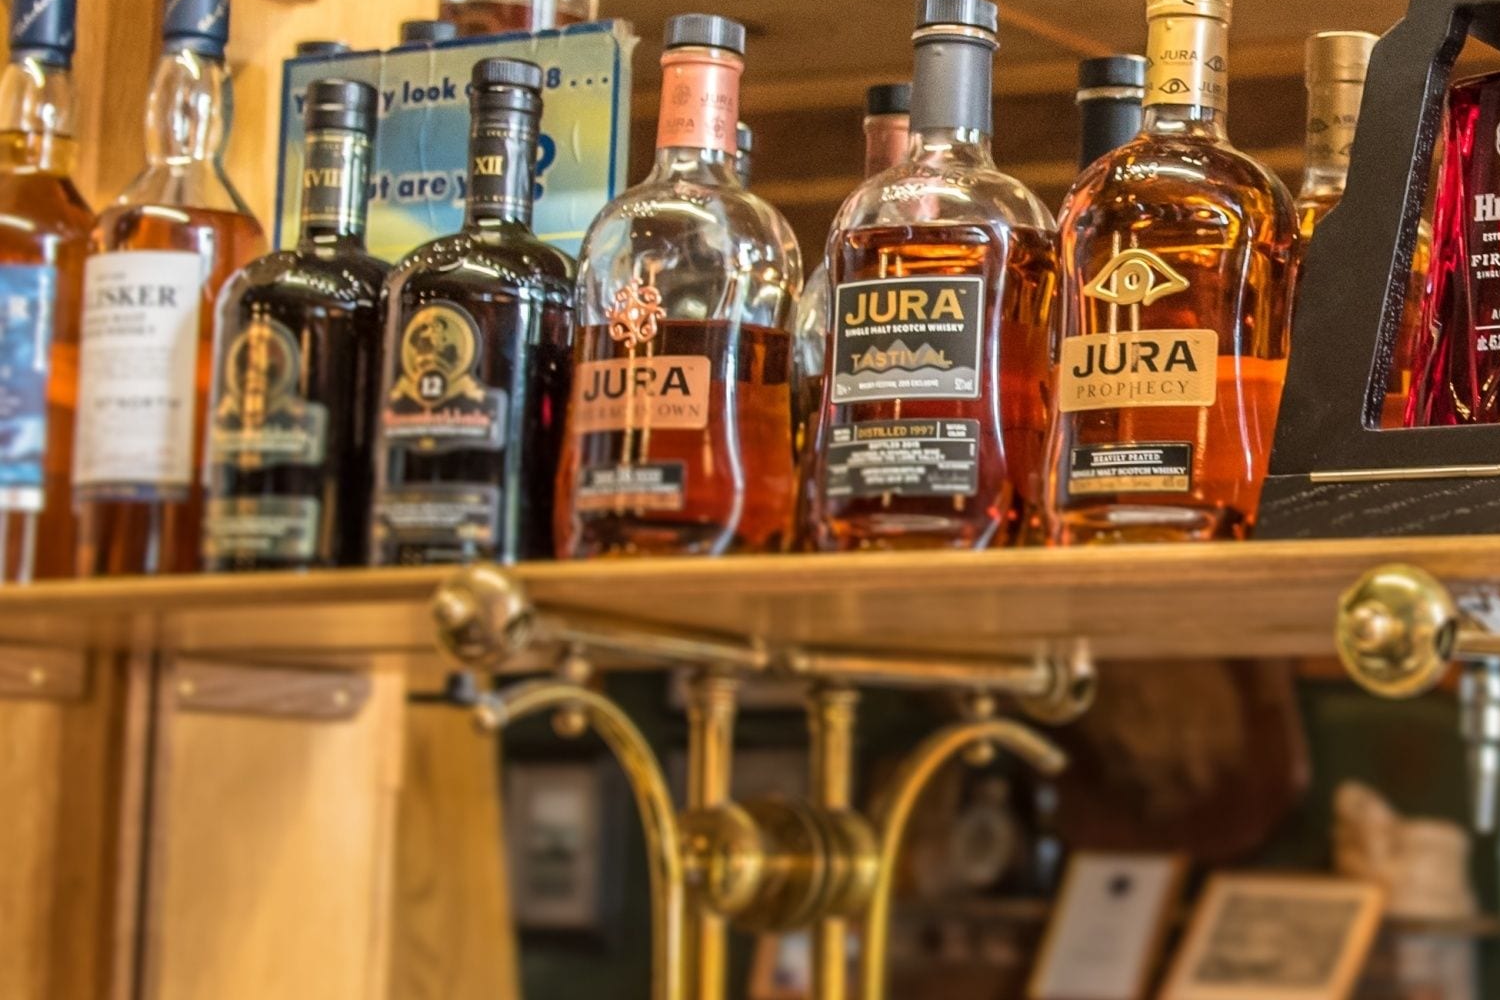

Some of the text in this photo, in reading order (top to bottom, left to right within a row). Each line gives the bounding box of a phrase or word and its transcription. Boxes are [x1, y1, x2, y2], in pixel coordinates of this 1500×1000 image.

[1160, 49, 1199, 61] JURA
[403, 77, 458, 103] look
[473, 156, 504, 176] XII
[398, 174, 447, 199] are
[845, 289, 965, 327] JURA
[845, 323, 965, 338] SINGLE MALT SCOTCH WHISKY
[851, 349, 953, 374] TASTIVAL
[1073, 340, 1198, 379] JURA
[583, 365, 692, 402] JURA
[1076, 380, 1189, 399] PROPHECY
[657, 403, 701, 418] OWN
[858, 425, 935, 438] DISTILLED 1997
[1128, 452, 1161, 462] PEATED
[1118, 467, 1152, 476] SCOTCH
[1152, 466, 1186, 476] WHISKY
